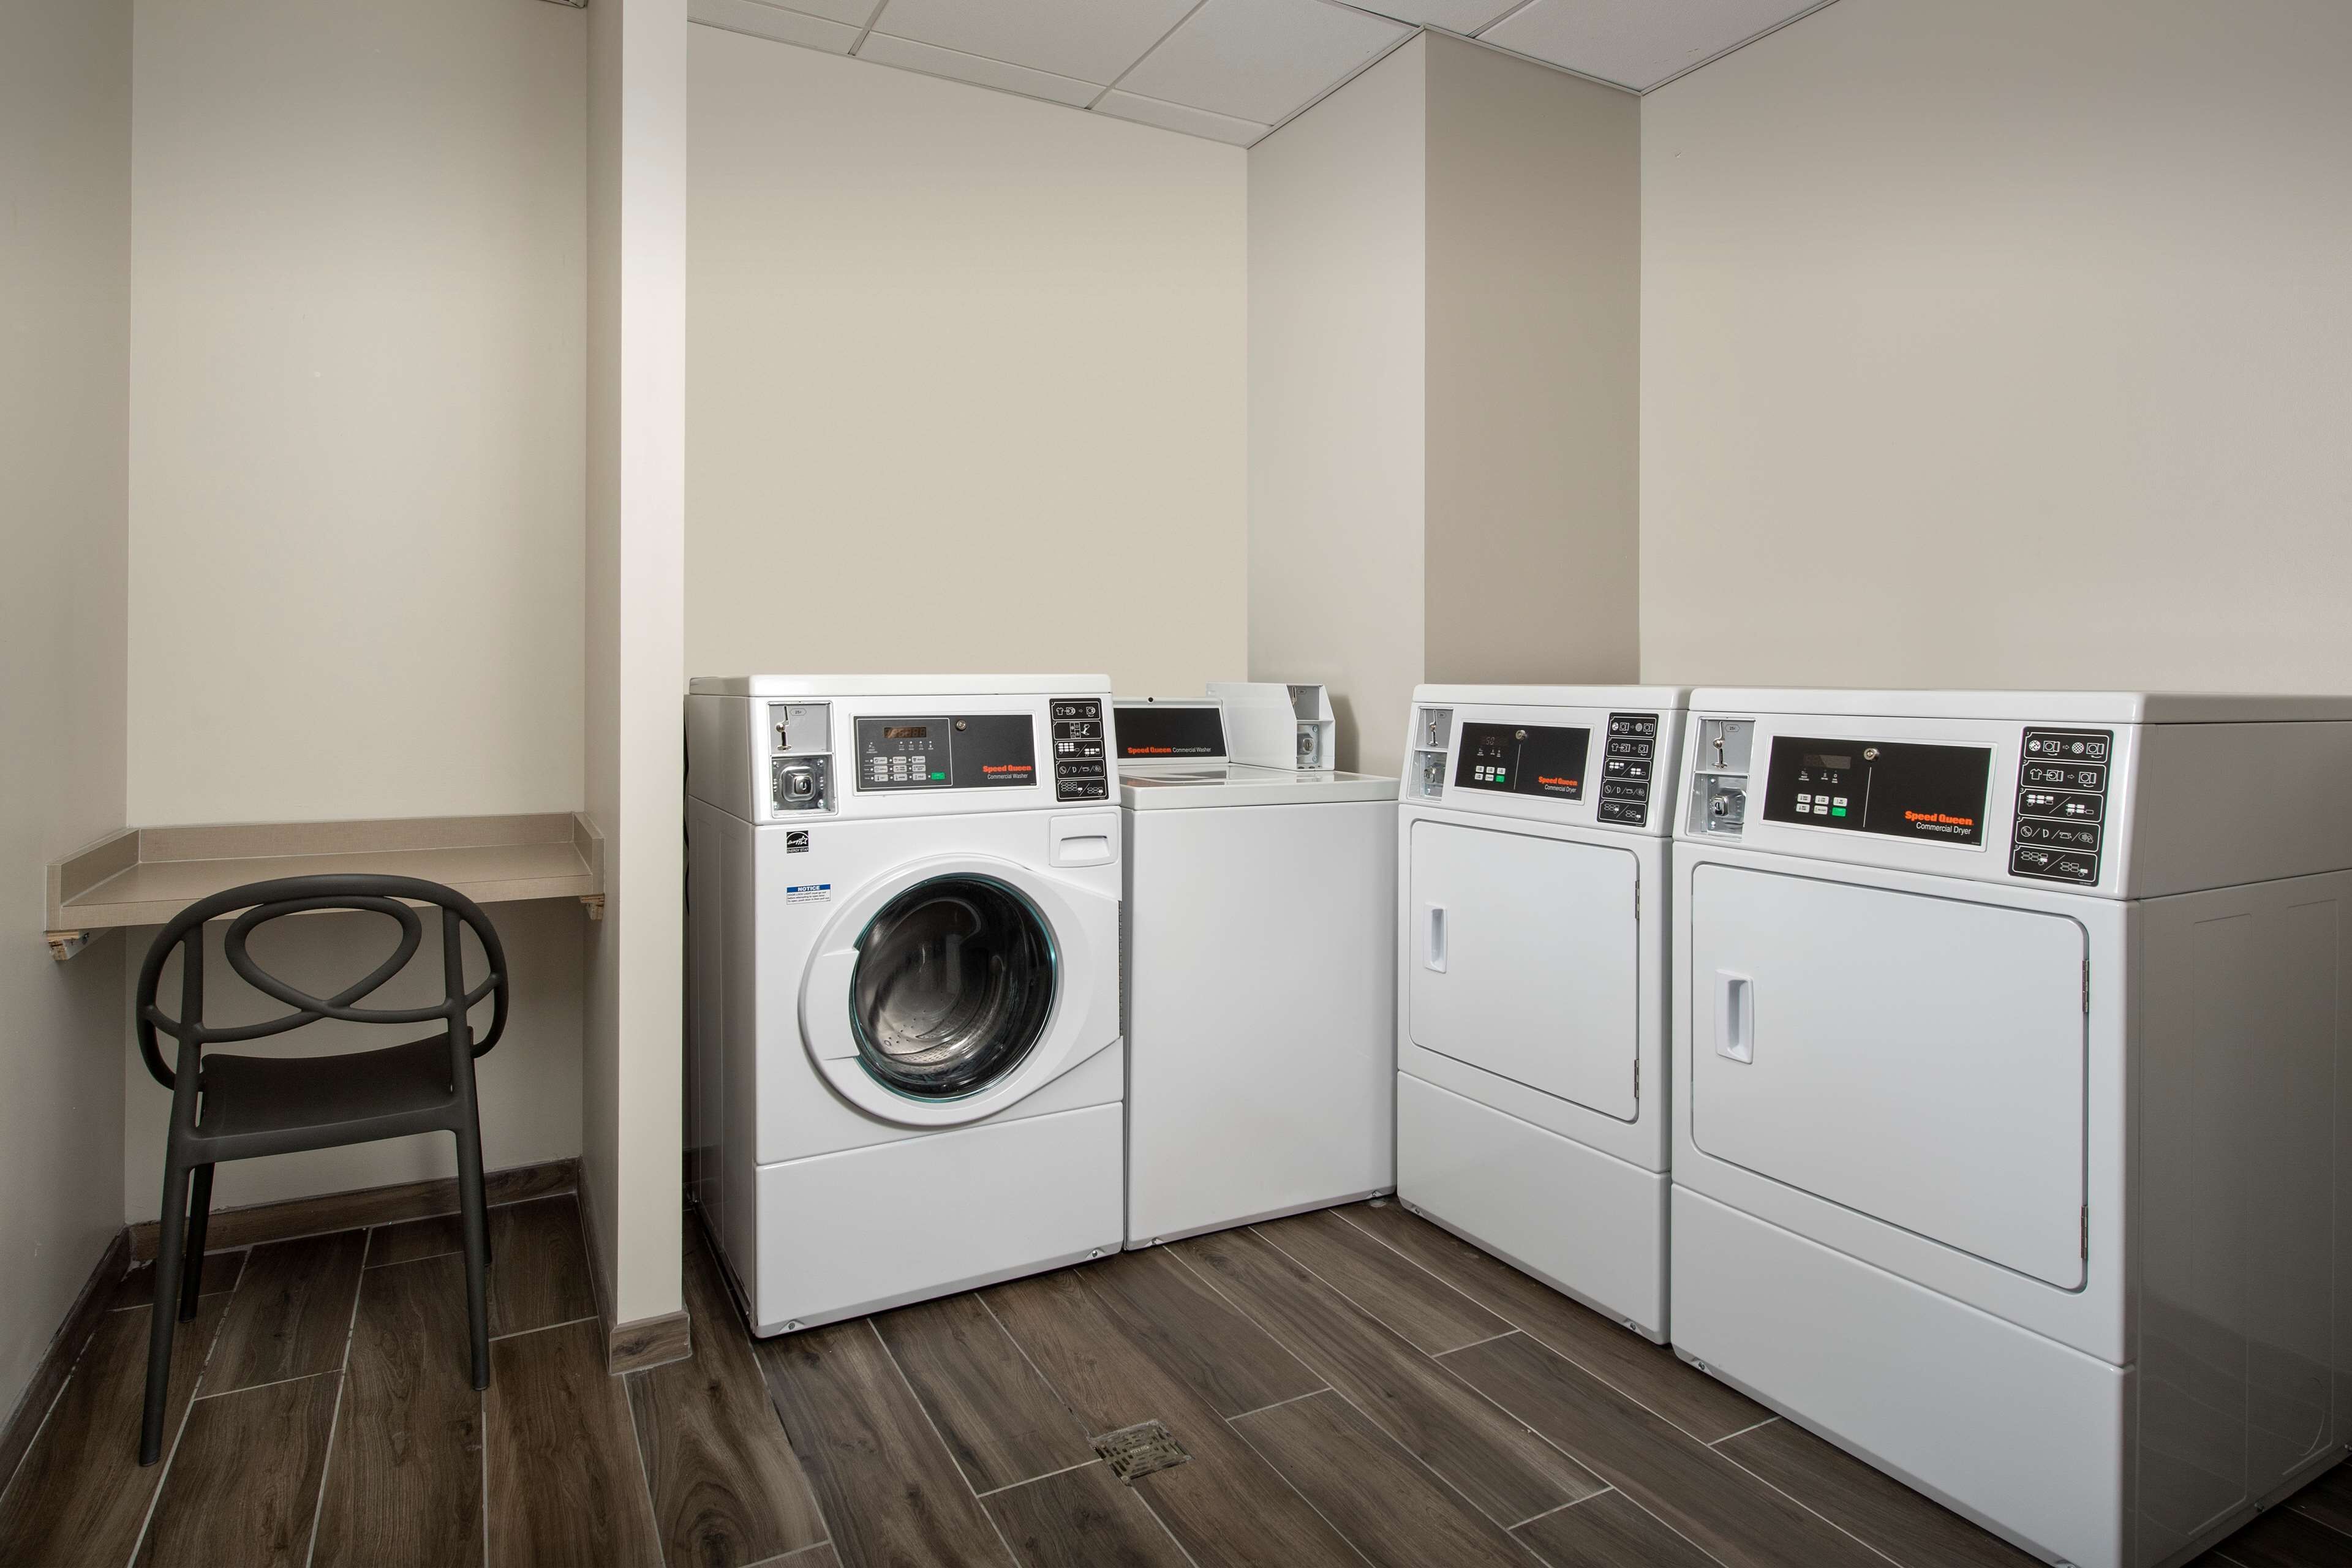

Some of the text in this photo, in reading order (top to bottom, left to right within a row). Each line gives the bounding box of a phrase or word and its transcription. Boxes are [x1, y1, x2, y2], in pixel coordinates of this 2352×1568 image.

[1128, 747, 1149, 755] Speed
[1150, 745, 1172, 753] Queen
[983, 765, 1007, 774] Speed
[1538, 776, 1578, 786] Speed Queen
[1905, 810, 1937, 821] Speed
[1916, 821, 1972, 836] Commercial Dryer
